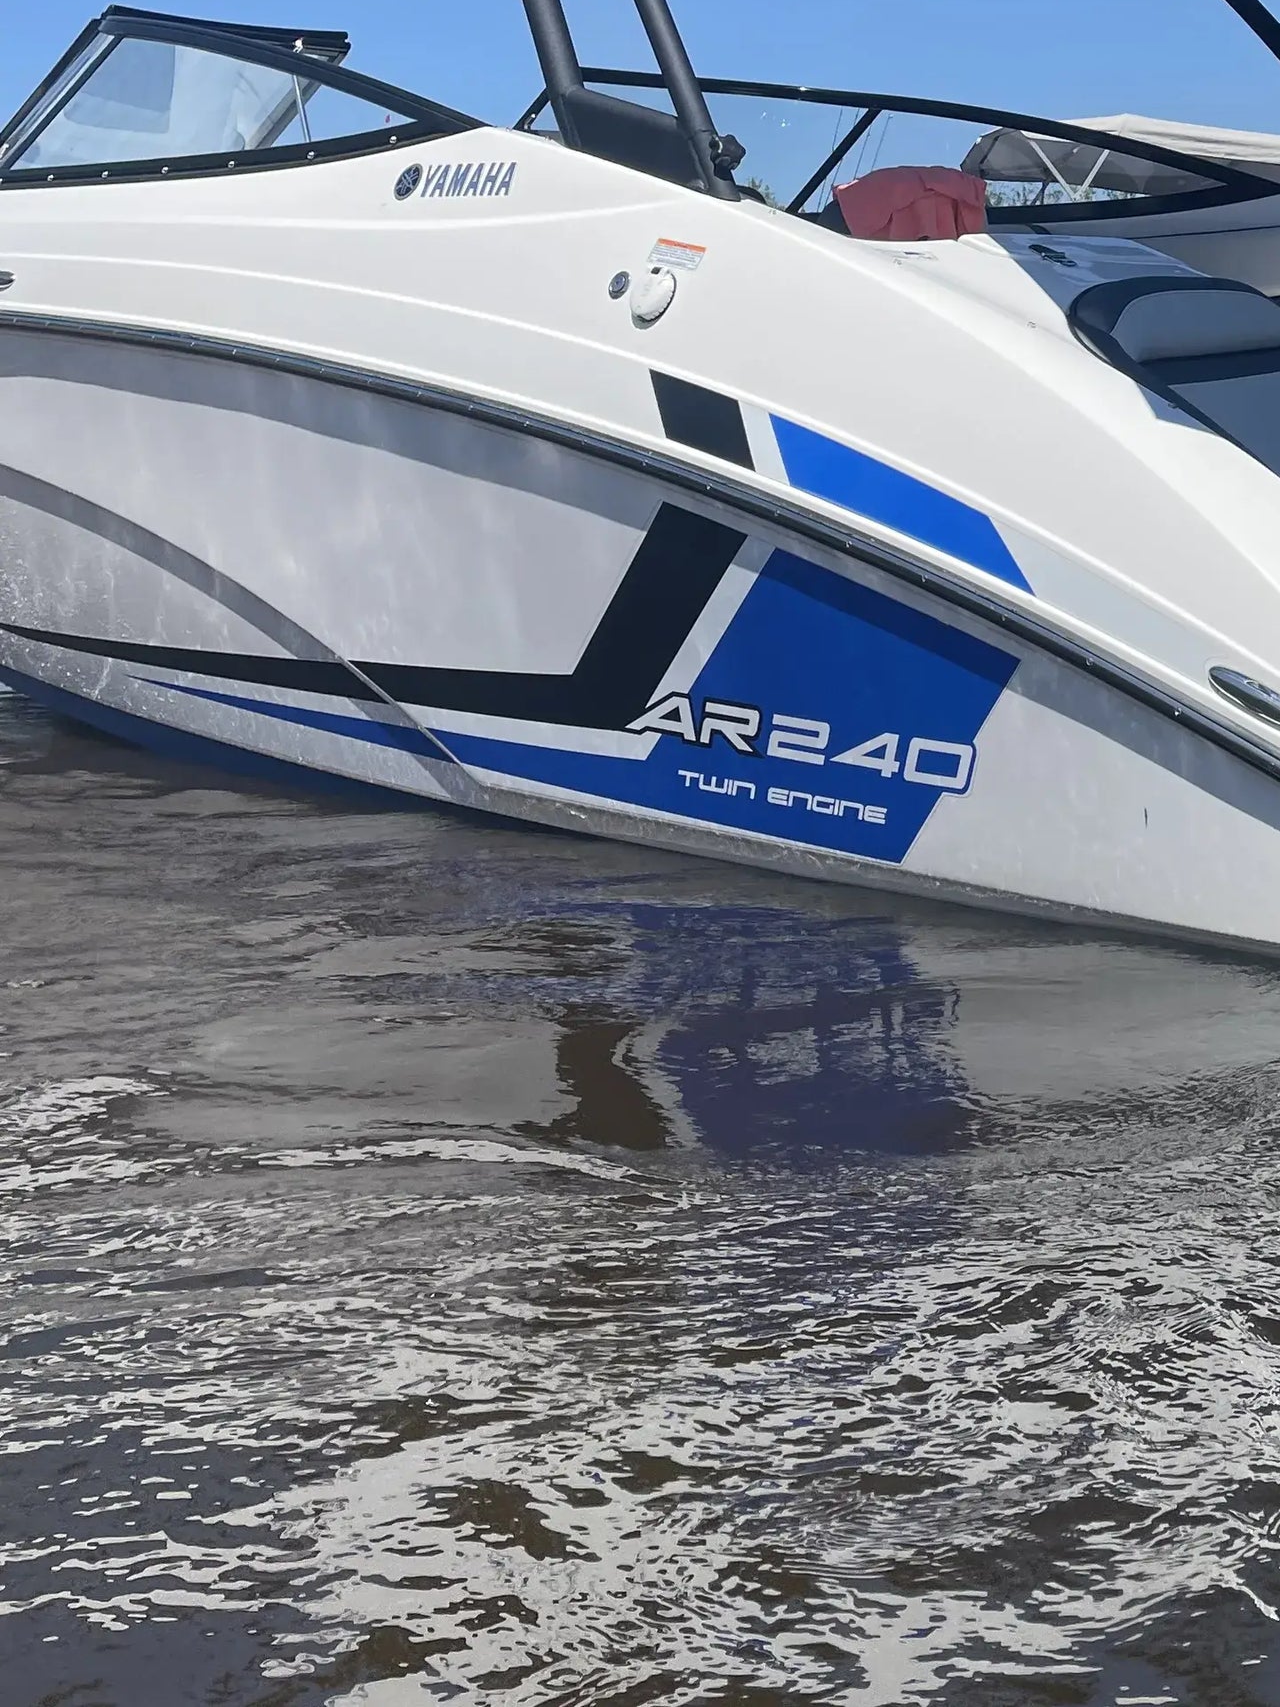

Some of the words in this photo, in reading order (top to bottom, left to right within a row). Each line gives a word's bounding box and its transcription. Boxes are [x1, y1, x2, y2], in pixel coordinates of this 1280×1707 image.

[420, 162, 517, 198] YAMAHA
[678, 769, 755, 800] TWIN
[767, 787, 888, 825] ENGINE
